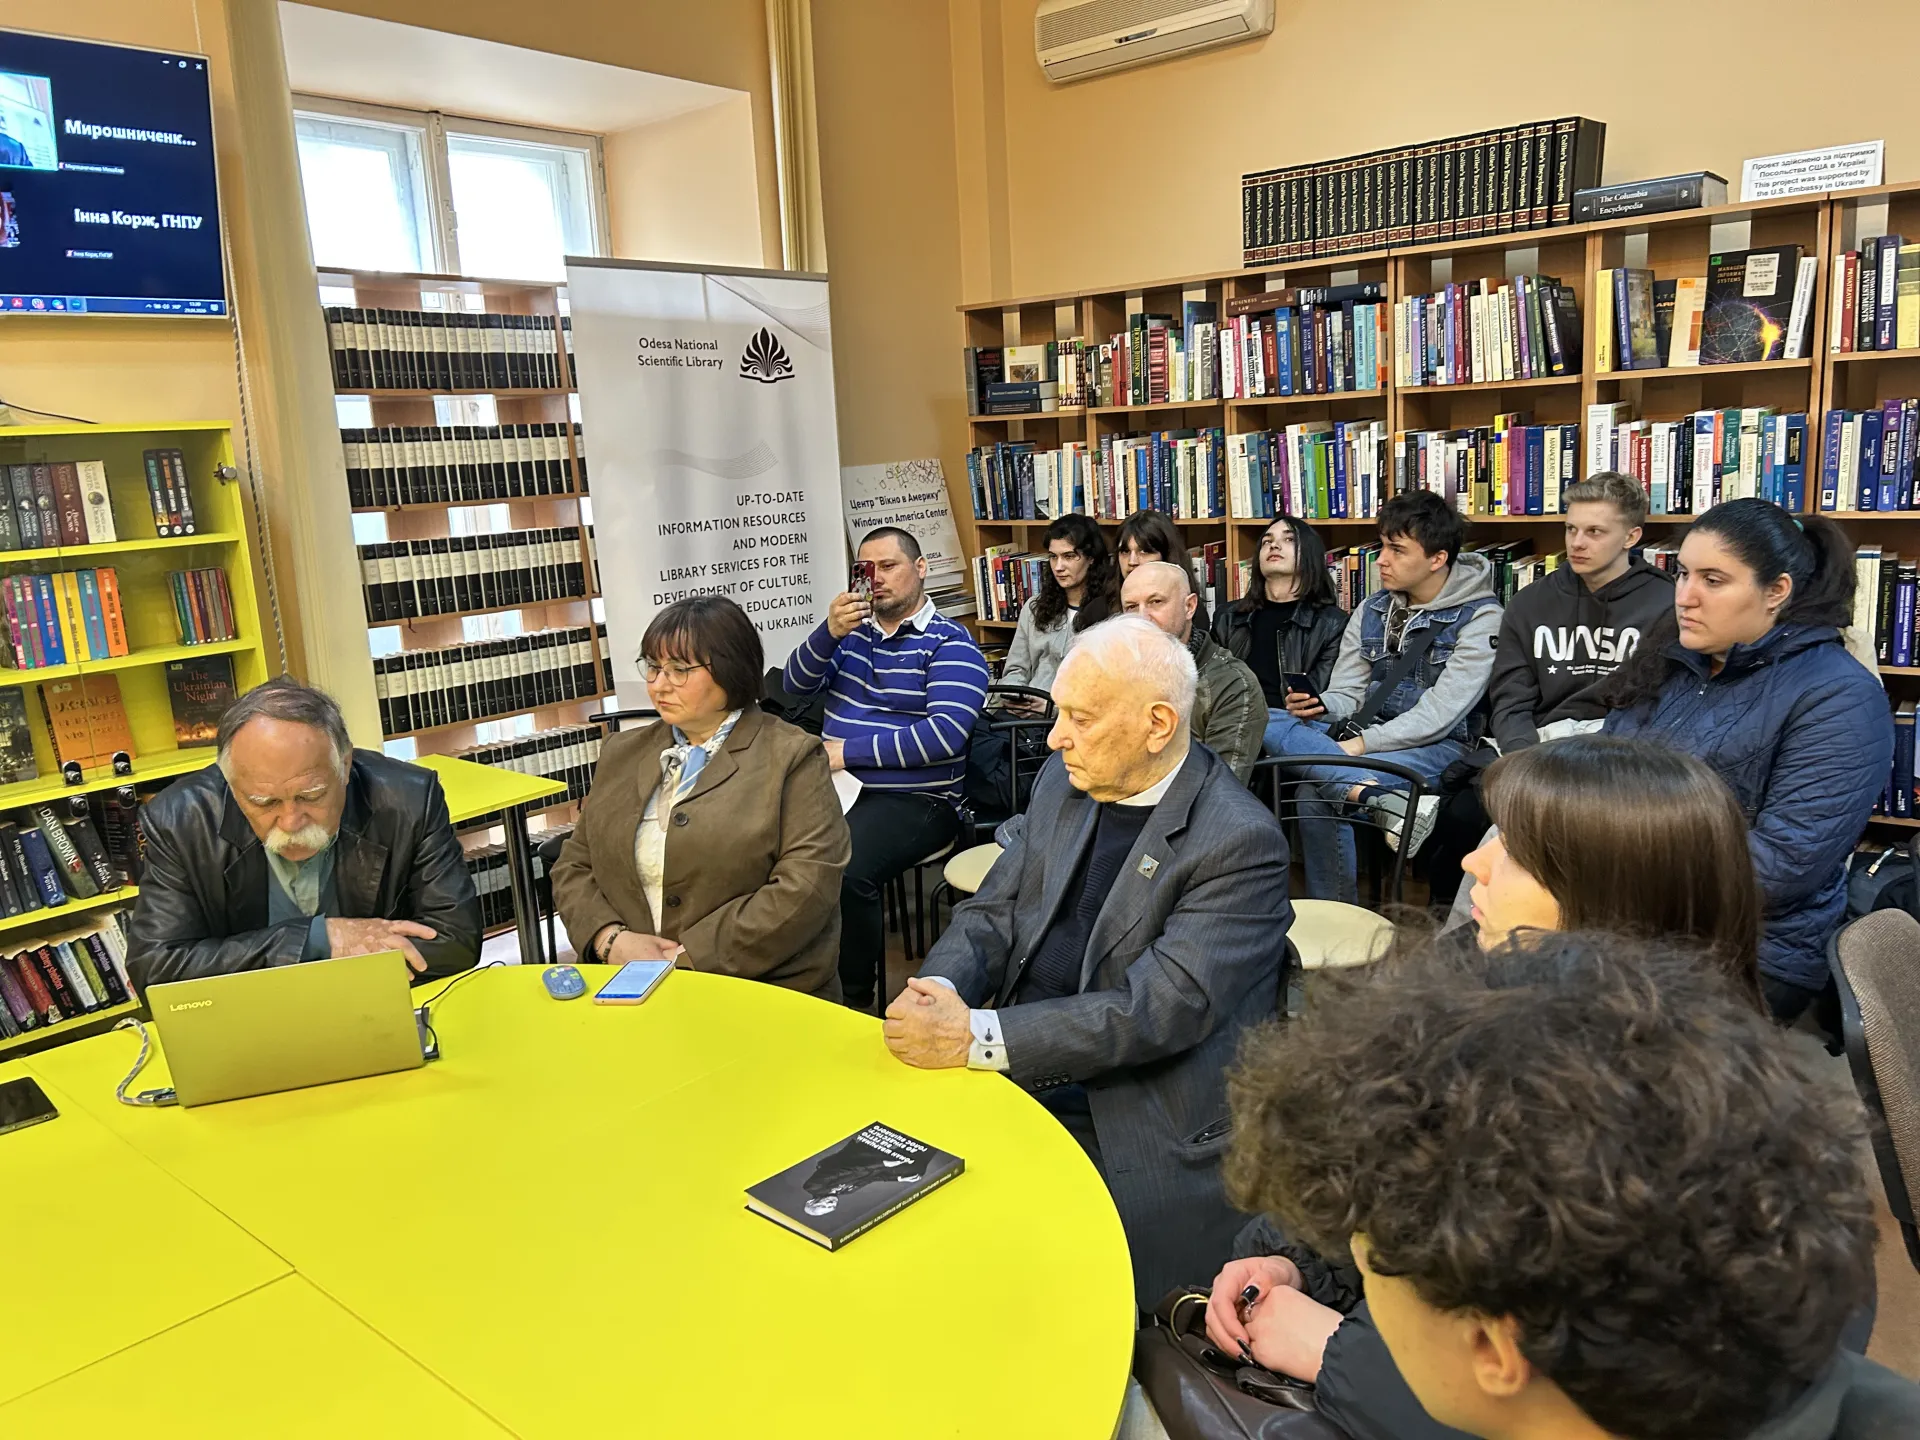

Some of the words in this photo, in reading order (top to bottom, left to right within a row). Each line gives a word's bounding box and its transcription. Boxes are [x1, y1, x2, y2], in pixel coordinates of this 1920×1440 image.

[64, 119, 196, 146] Мирошниченк...
[1781, 157, 1821, 167] здійснено
[1834, 149, 1875, 160] підтримки
[1760, 168, 1806, 178] Посольства
[1837, 159, 1866, 167] Україні
[1772, 178, 1799, 188] project
[1818, 171, 1858, 180] supported
[1860, 169, 1869, 177] by
[1600, 195, 1613, 203] The
[1614, 191, 1648, 201] Columbia
[1788, 184, 1823, 193] Embassy
[1600, 203, 1643, 215] Encyclopedia
[74, 208, 110, 224] Інна
[112, 211, 159, 229] Корж,
[162, 214, 202, 229] ГНПУ
[1884, 250, 1892, 303] INVESTMENTS
[1231, 297, 1257, 306] BUSINESS
[1862, 270, 1870, 323] INVESTMENTS
[639, 338, 672, 350] Odesa
[675, 339, 718, 350] National
[1202, 335, 1210, 369] TITAN
[638, 355, 683, 367] Scientific
[686, 356, 723, 369] Library
[1696, 448, 1704, 480] Management
[737, 491, 804, 507] UP-TO-DATE
[850, 500, 874, 510] Центр
[875, 496, 900, 506] "Вікно
[908, 490, 941, 502] Америку"
[658, 518, 740, 536] INFORMATION
[743, 512, 806, 528] RESOURCES
[852, 516, 882, 528] Window
[885, 516, 894, 524] on
[896, 512, 924, 522] America
[926, 508, 948, 518] Center
[733, 538, 756, 551] AND
[760, 532, 808, 548] MODERN
[660, 565, 707, 582] LIBRARY
[712, 559, 759, 576] SERVICES
[763, 556, 786, 569] FOR
[789, 552, 809, 565] THE
[654, 584, 736, 606] DEVELOPMENT
[739, 579, 754, 592] OF
[759, 573, 811, 590] CULTURE,
[747, 594, 812, 612] EDUCATION
[767, 614, 814, 630] UKRAINE
[1534, 625, 1640, 662] NASA
[189, 671, 208, 681] The
[174, 681, 227, 692] Ukrainian
[186, 691, 217, 702] Night
[40, 808, 58, 831] DAN
[51, 828, 78, 866] BROWN
[43, 875, 53, 892] POINT
[90, 935, 101, 953] sidney
[97, 950, 111, 972] sheldon
[39, 948, 52, 969] sidney
[46, 966, 64, 990] sheldon
[170, 1000, 212, 1012] Lenovo
[862, 1132, 881, 1142] ГЕТТО
[906, 1140, 927, 1152] ГОЛОС
[891, 1152, 914, 1164] РОМАН
